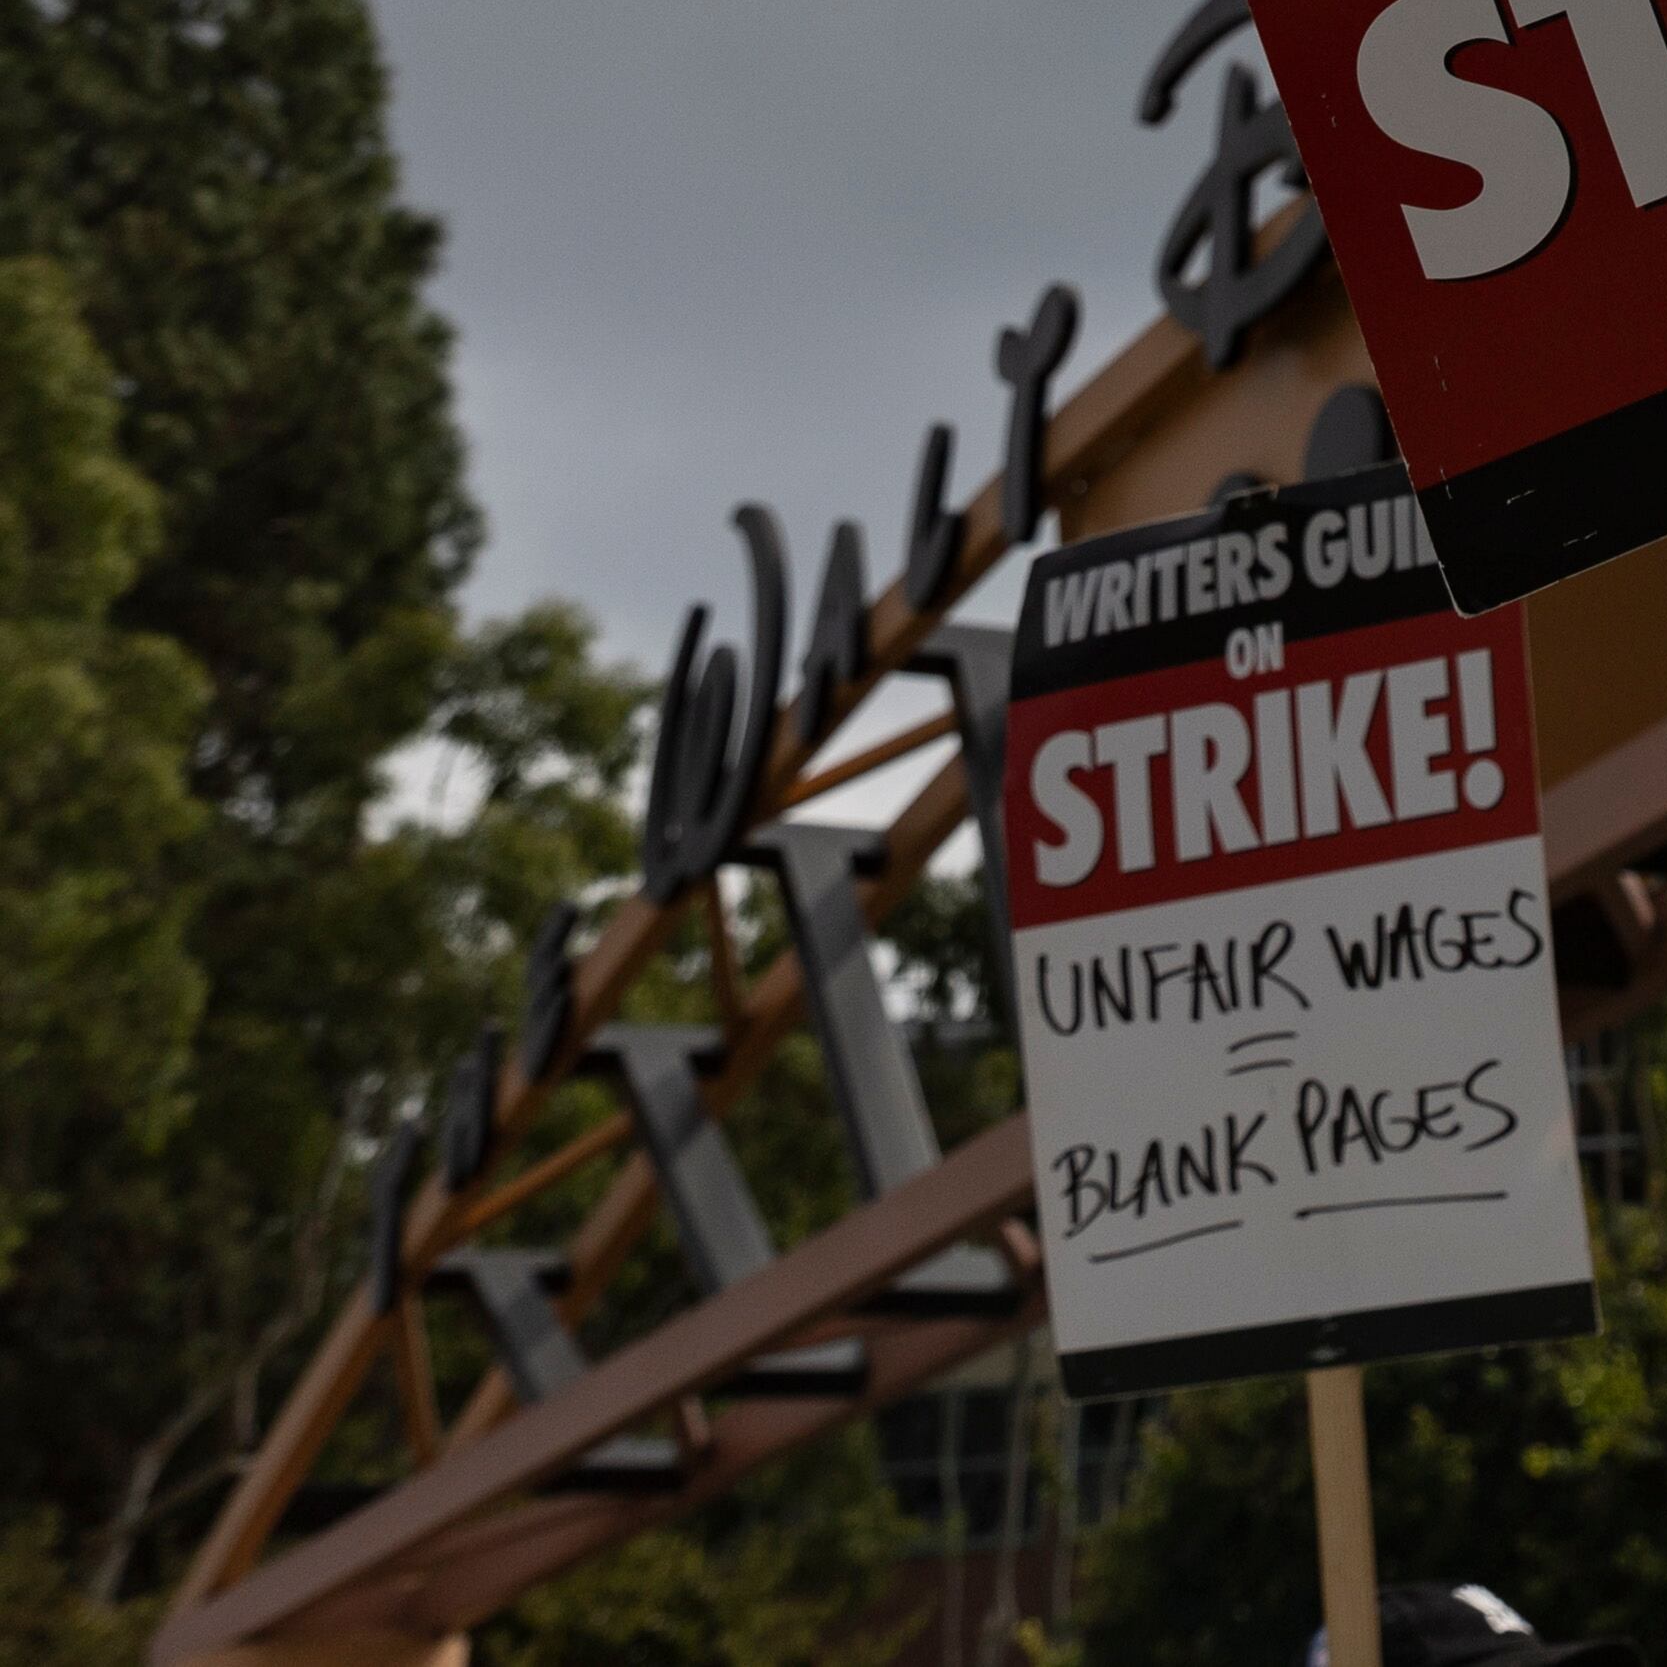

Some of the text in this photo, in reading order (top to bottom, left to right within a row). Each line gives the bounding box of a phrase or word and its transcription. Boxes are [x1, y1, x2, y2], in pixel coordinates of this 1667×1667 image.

[1042, 522, 1293, 649] WRITERS
[1225, 621, 1285, 680] ON
[1031, 648, 1505, 888] STRIKE!
[1035, 887, 1545, 1037] UNFAIR WAGES
[1052, 1058, 1519, 1239] BLANK PAGES
